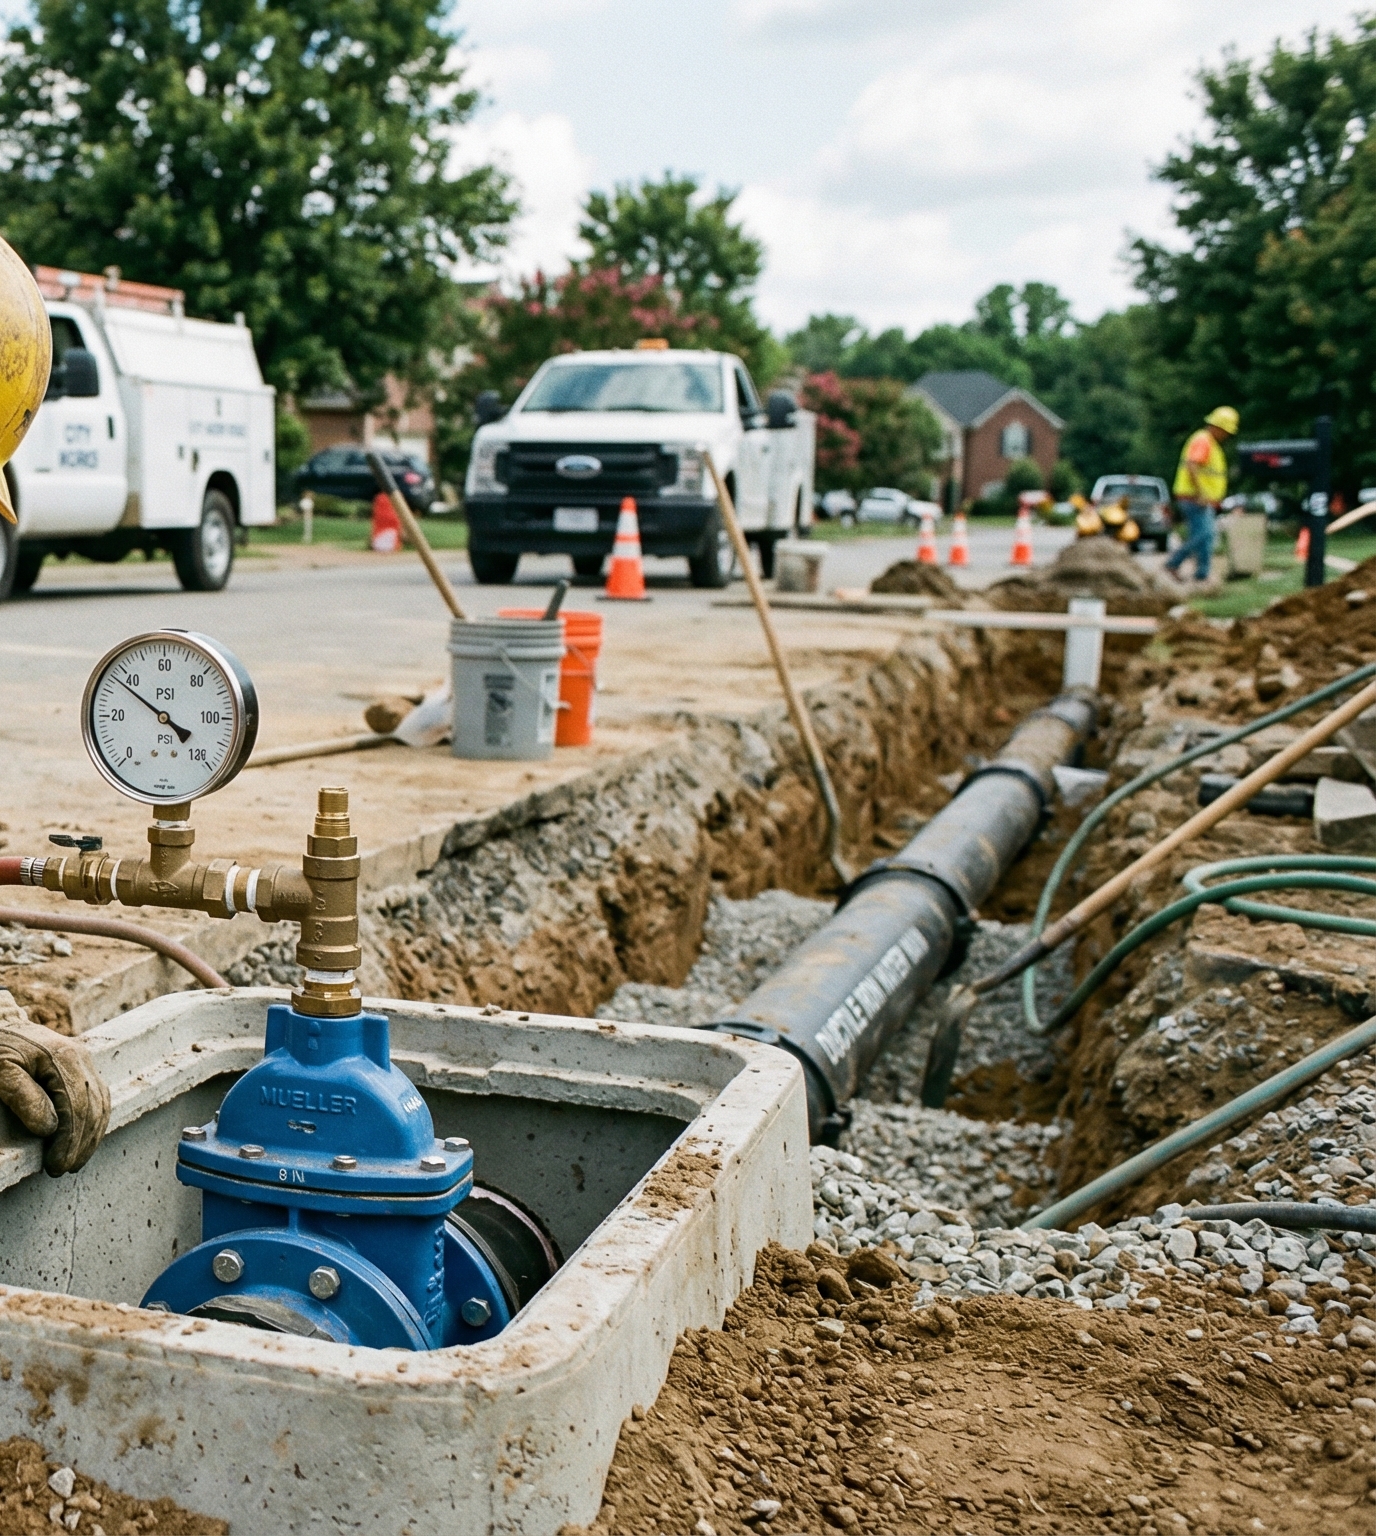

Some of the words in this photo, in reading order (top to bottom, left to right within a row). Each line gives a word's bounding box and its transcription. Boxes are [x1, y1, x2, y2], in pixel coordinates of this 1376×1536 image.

[158, 659, 172, 671] 60
[126, 674, 140, 687] 40
[190, 675, 204, 687] 80
[156, 688, 174, 700] PSI
[111, 709, 125, 721] 20
[201, 711, 220, 724] 100
[158, 735, 173, 745] PSI
[126, 747, 133, 759] 0
[261, 1085, 357, 1115] MUELLER
[279, 1168, 288, 1181] 8
[292, 1169, 305, 1183] IN
